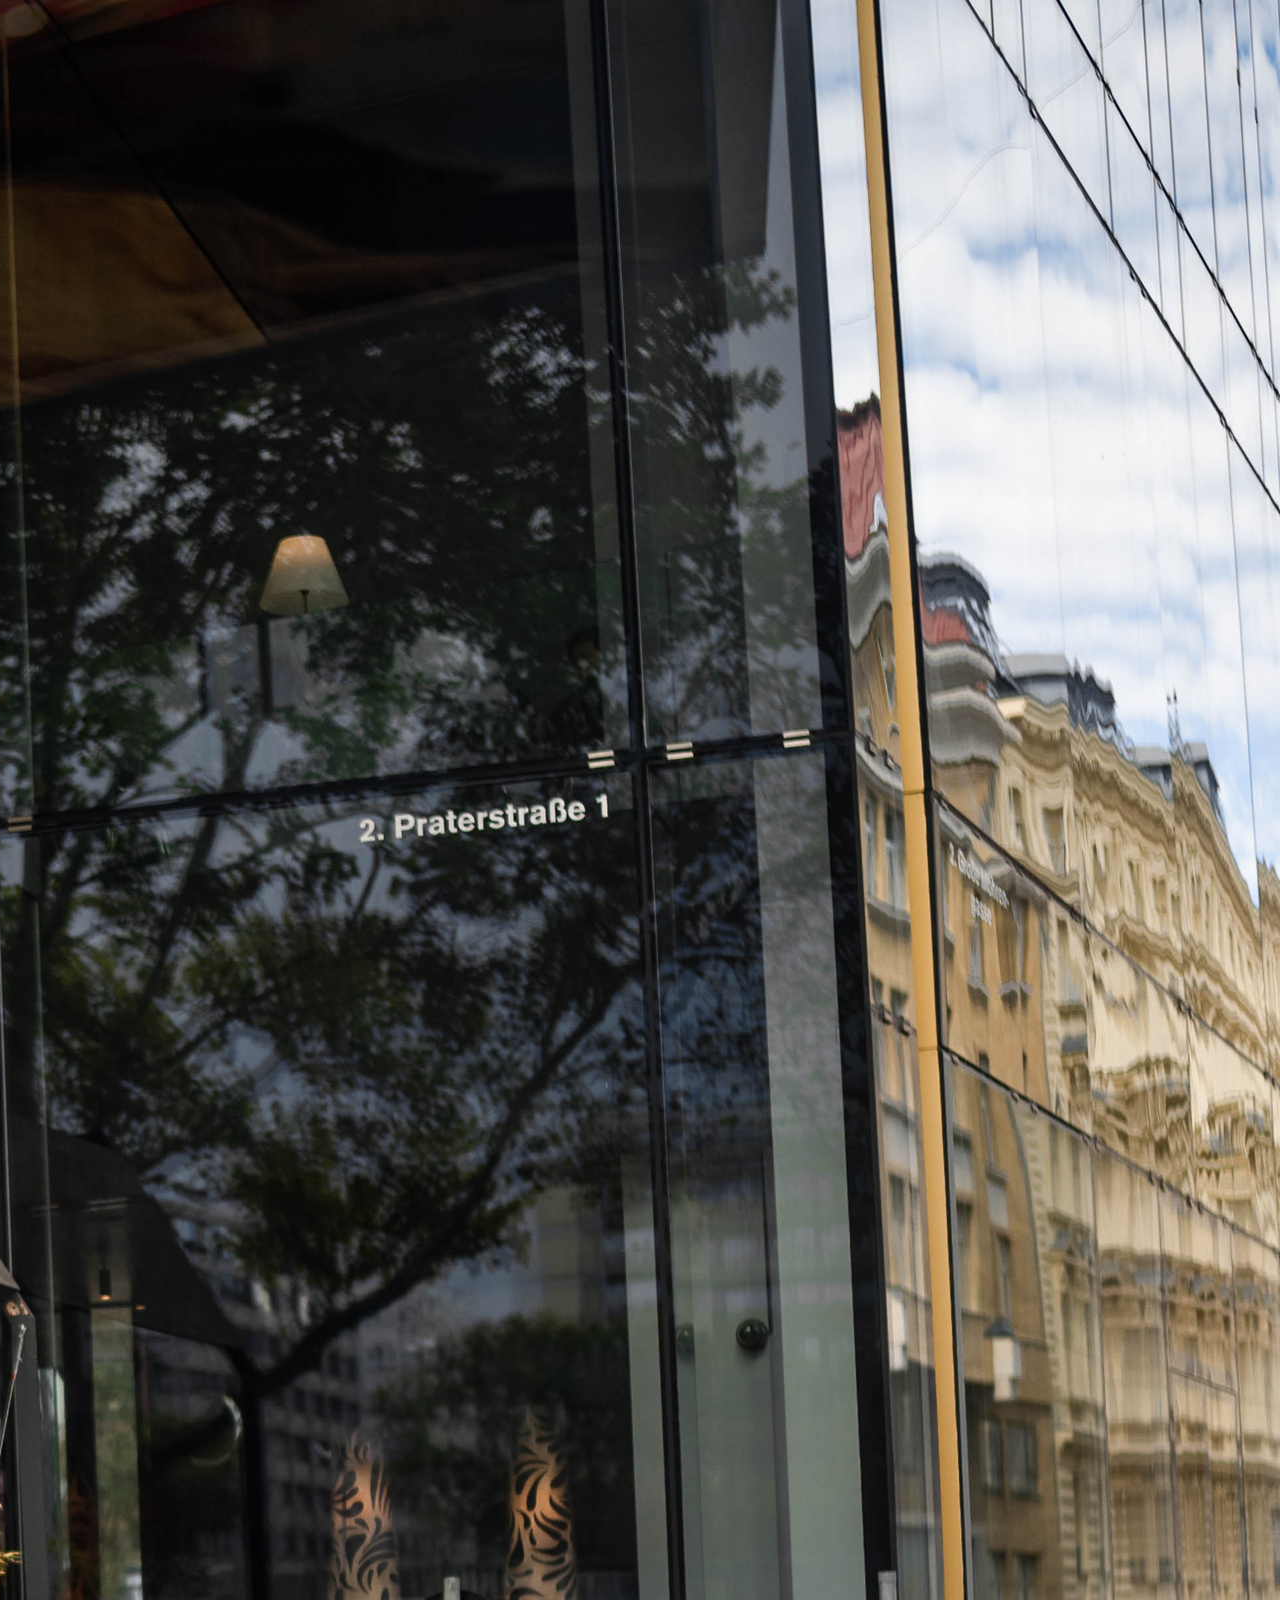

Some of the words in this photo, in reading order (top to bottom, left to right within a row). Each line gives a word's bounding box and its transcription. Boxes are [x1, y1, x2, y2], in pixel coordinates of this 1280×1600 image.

[359, 819, 384, 843] 2.
[394, 797, 587, 839] Praterstraße
[596, 793, 609, 818] 1
